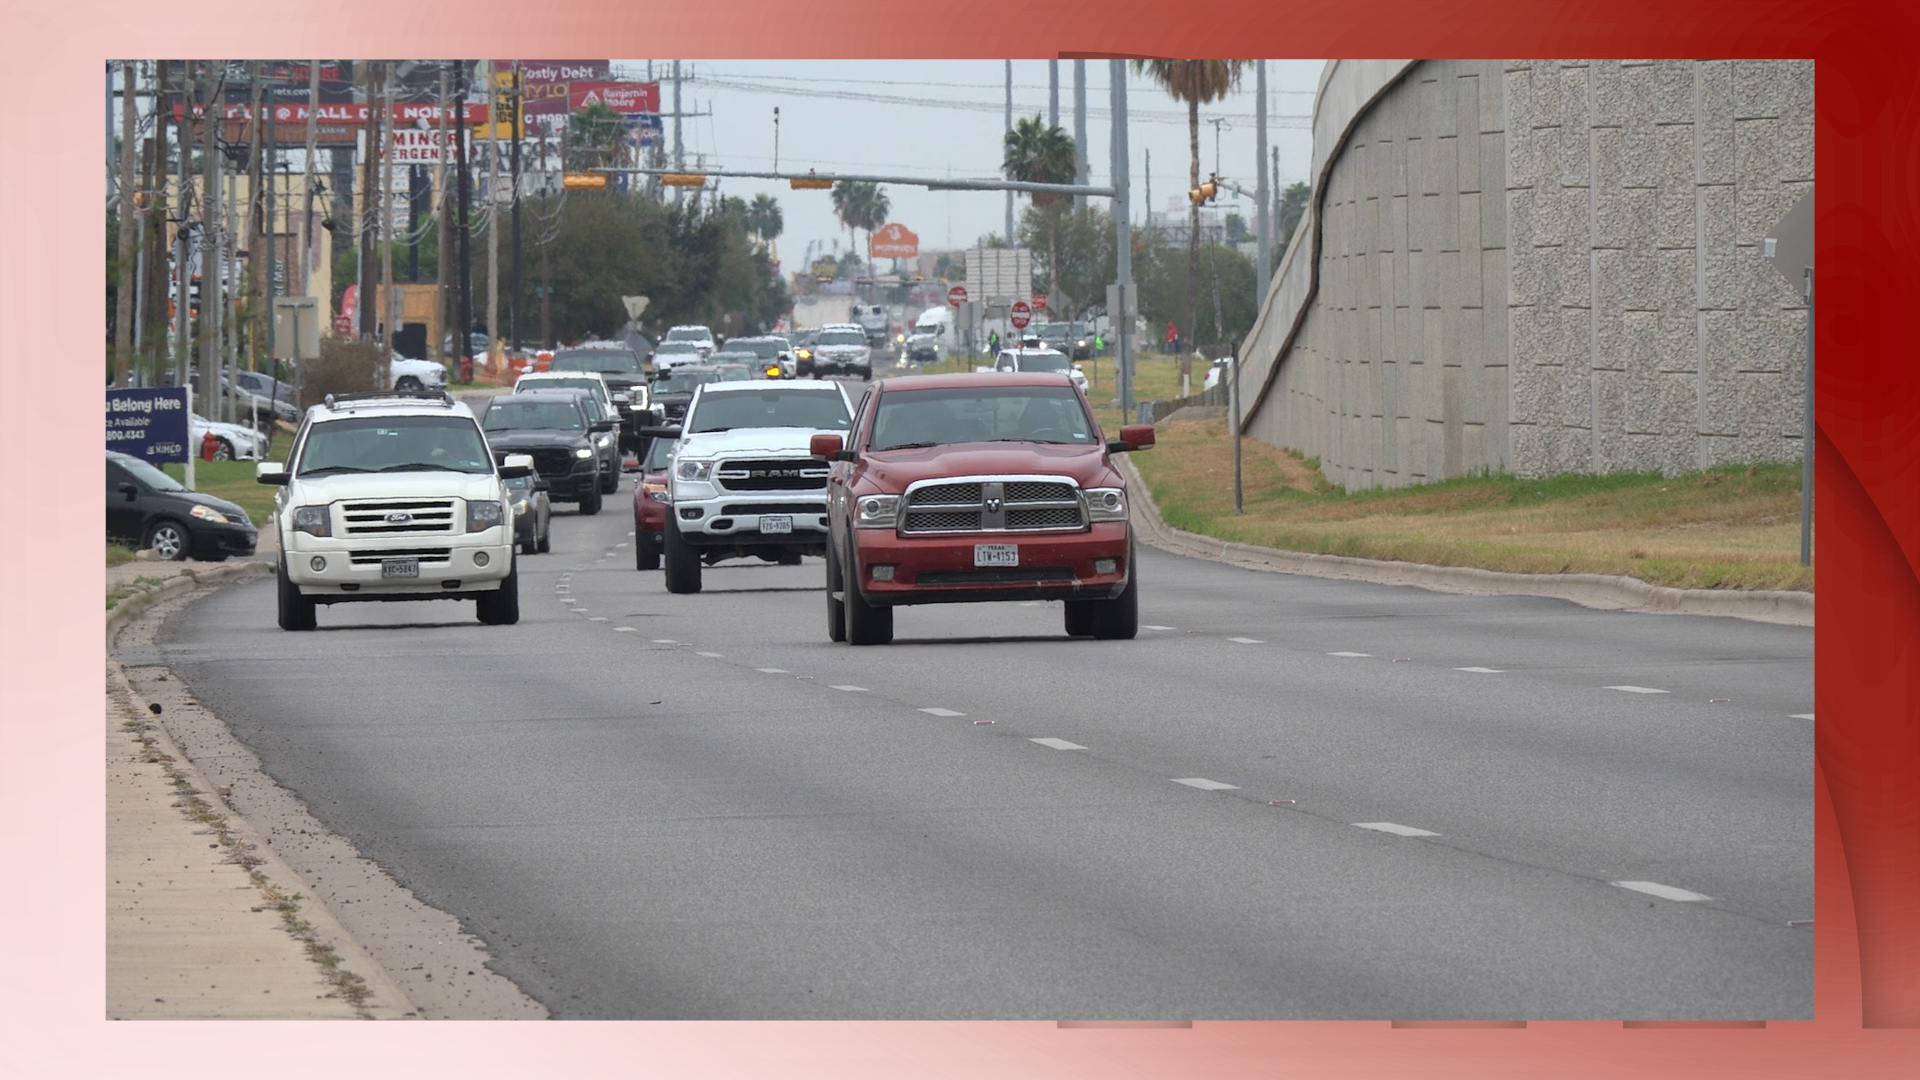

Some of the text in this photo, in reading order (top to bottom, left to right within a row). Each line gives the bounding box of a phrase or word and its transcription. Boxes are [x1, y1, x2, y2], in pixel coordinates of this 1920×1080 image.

[561, 66, 594, 79] Debt
[603, 88, 648, 102] Benjamin
[296, 107, 353, 119] MALL
[403, 106, 471, 119] NORTE
[392, 132, 458, 146] MINOR
[273, 259, 284, 282] Mar
[112, 397, 152, 413] Belong
[154, 396, 181, 410] Here
[114, 416, 151, 427] Available
[751, 469, 799, 478] RAM
